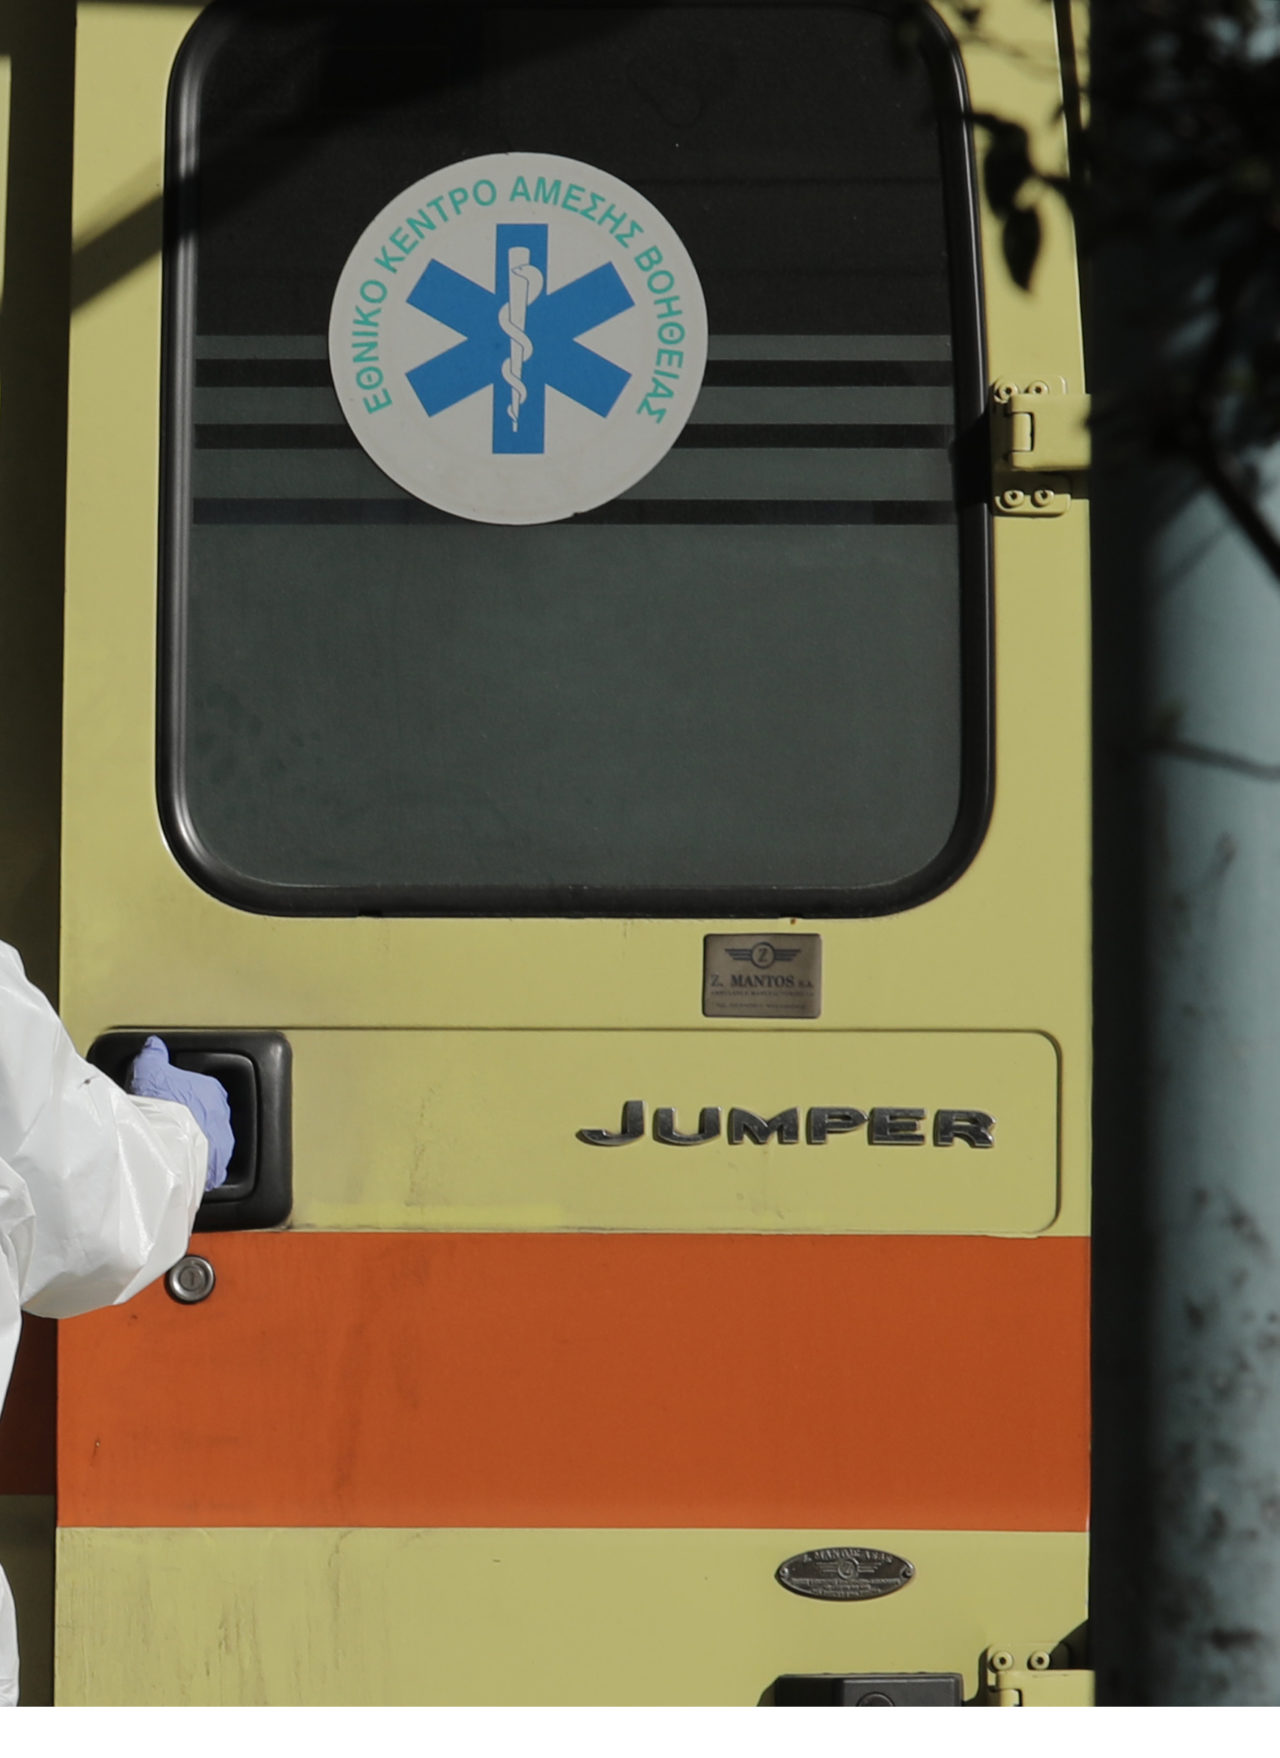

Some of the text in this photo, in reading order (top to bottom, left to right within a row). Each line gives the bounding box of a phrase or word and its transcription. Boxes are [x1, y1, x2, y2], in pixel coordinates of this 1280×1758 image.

[351, 175, 686, 424] ΕΘΝΙΚΟ ΚΕΝΤΡΟ ΑΜΕΣΗΣ ΒΟΗΘΕΙΑΣ
[730, 974, 795, 988] MANTOS
[576, 1100, 996, 1148] JUMPER
